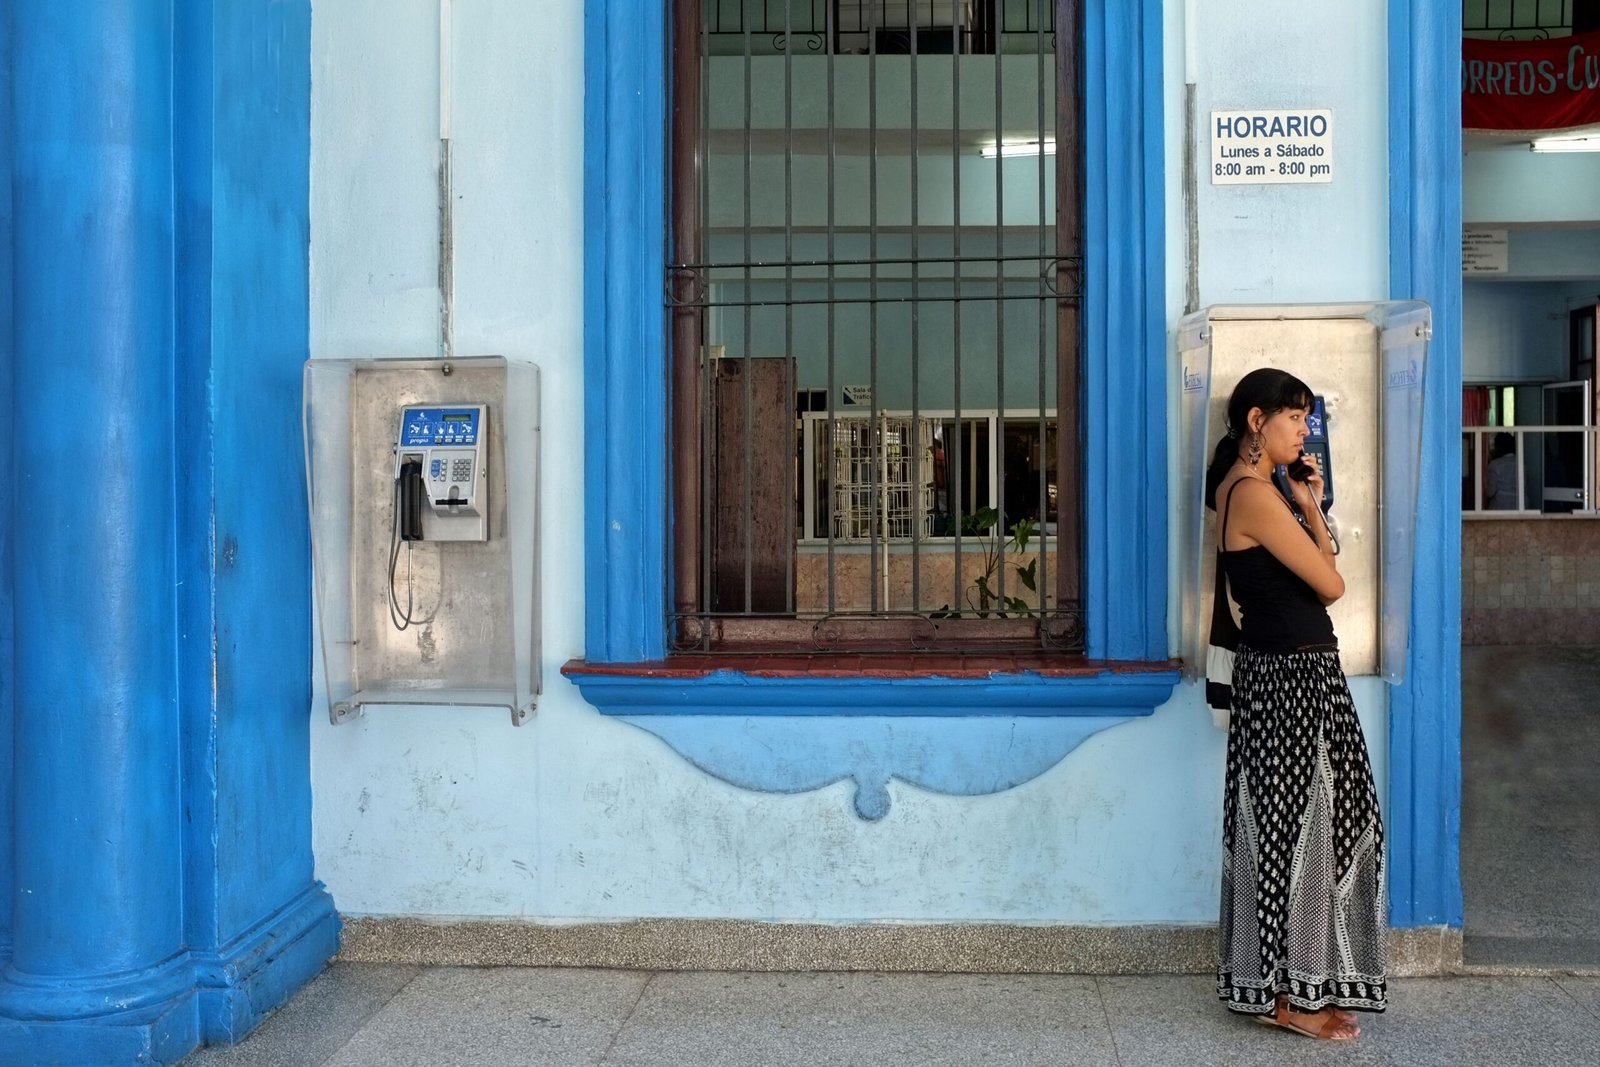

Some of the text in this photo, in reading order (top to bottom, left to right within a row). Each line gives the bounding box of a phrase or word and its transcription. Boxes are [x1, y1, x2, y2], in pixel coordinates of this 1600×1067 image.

[1217, 115, 1327, 138] HORARIO
[1221, 144, 1324, 158] Lunes a Sábado
[1215, 163, 1241, 176] 8:00
[1245, 165, 1265, 175] am
[1279, 162, 1305, 175] 8:00
[1309, 164, 1330, 177] pm
